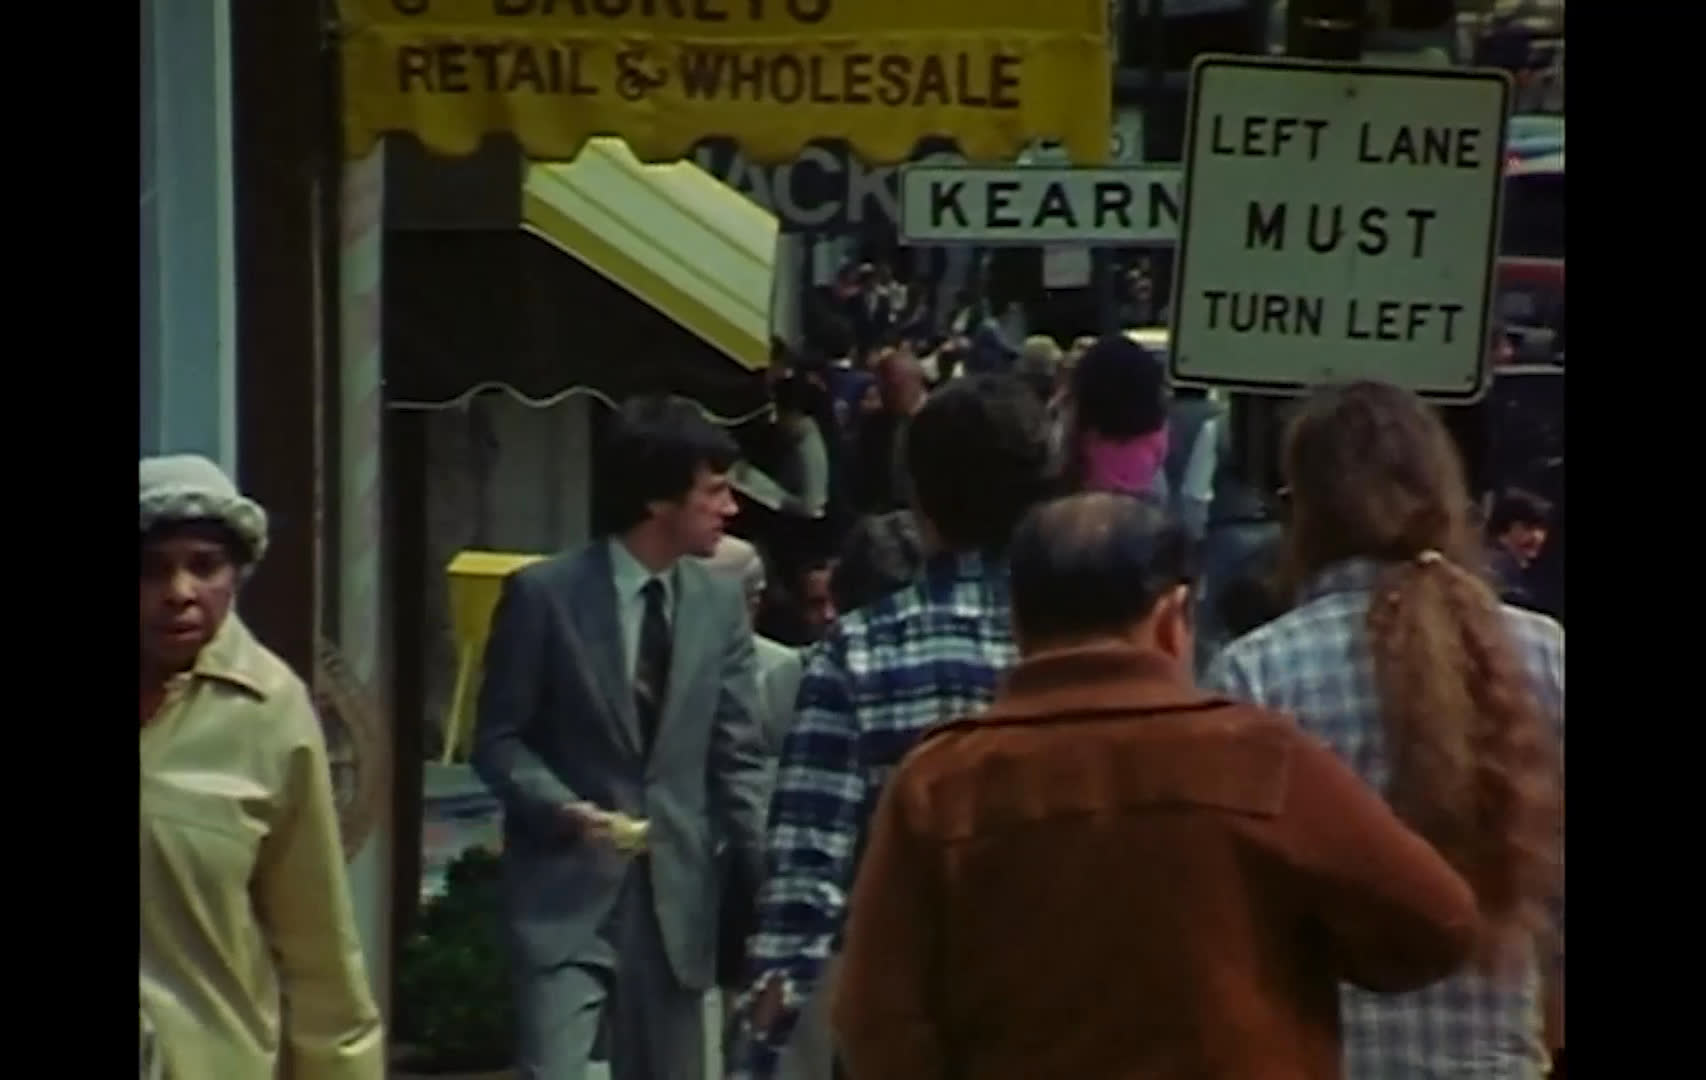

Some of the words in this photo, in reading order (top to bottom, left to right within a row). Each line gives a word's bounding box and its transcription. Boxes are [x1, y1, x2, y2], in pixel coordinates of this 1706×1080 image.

[399, 44, 599, 94] RETAIL
[616, 49, 668, 101] &
[682, 48, 1022, 107] WHOLESALE
[1212, 115, 1329, 160] LEFT
[1358, 123, 1481, 168] LANE
[931, 182, 1178, 227] KEARN
[1246, 201, 1437, 258] MUST
[1204, 291, 1323, 336] TURN
[1347, 299, 1464, 342] LEFT
